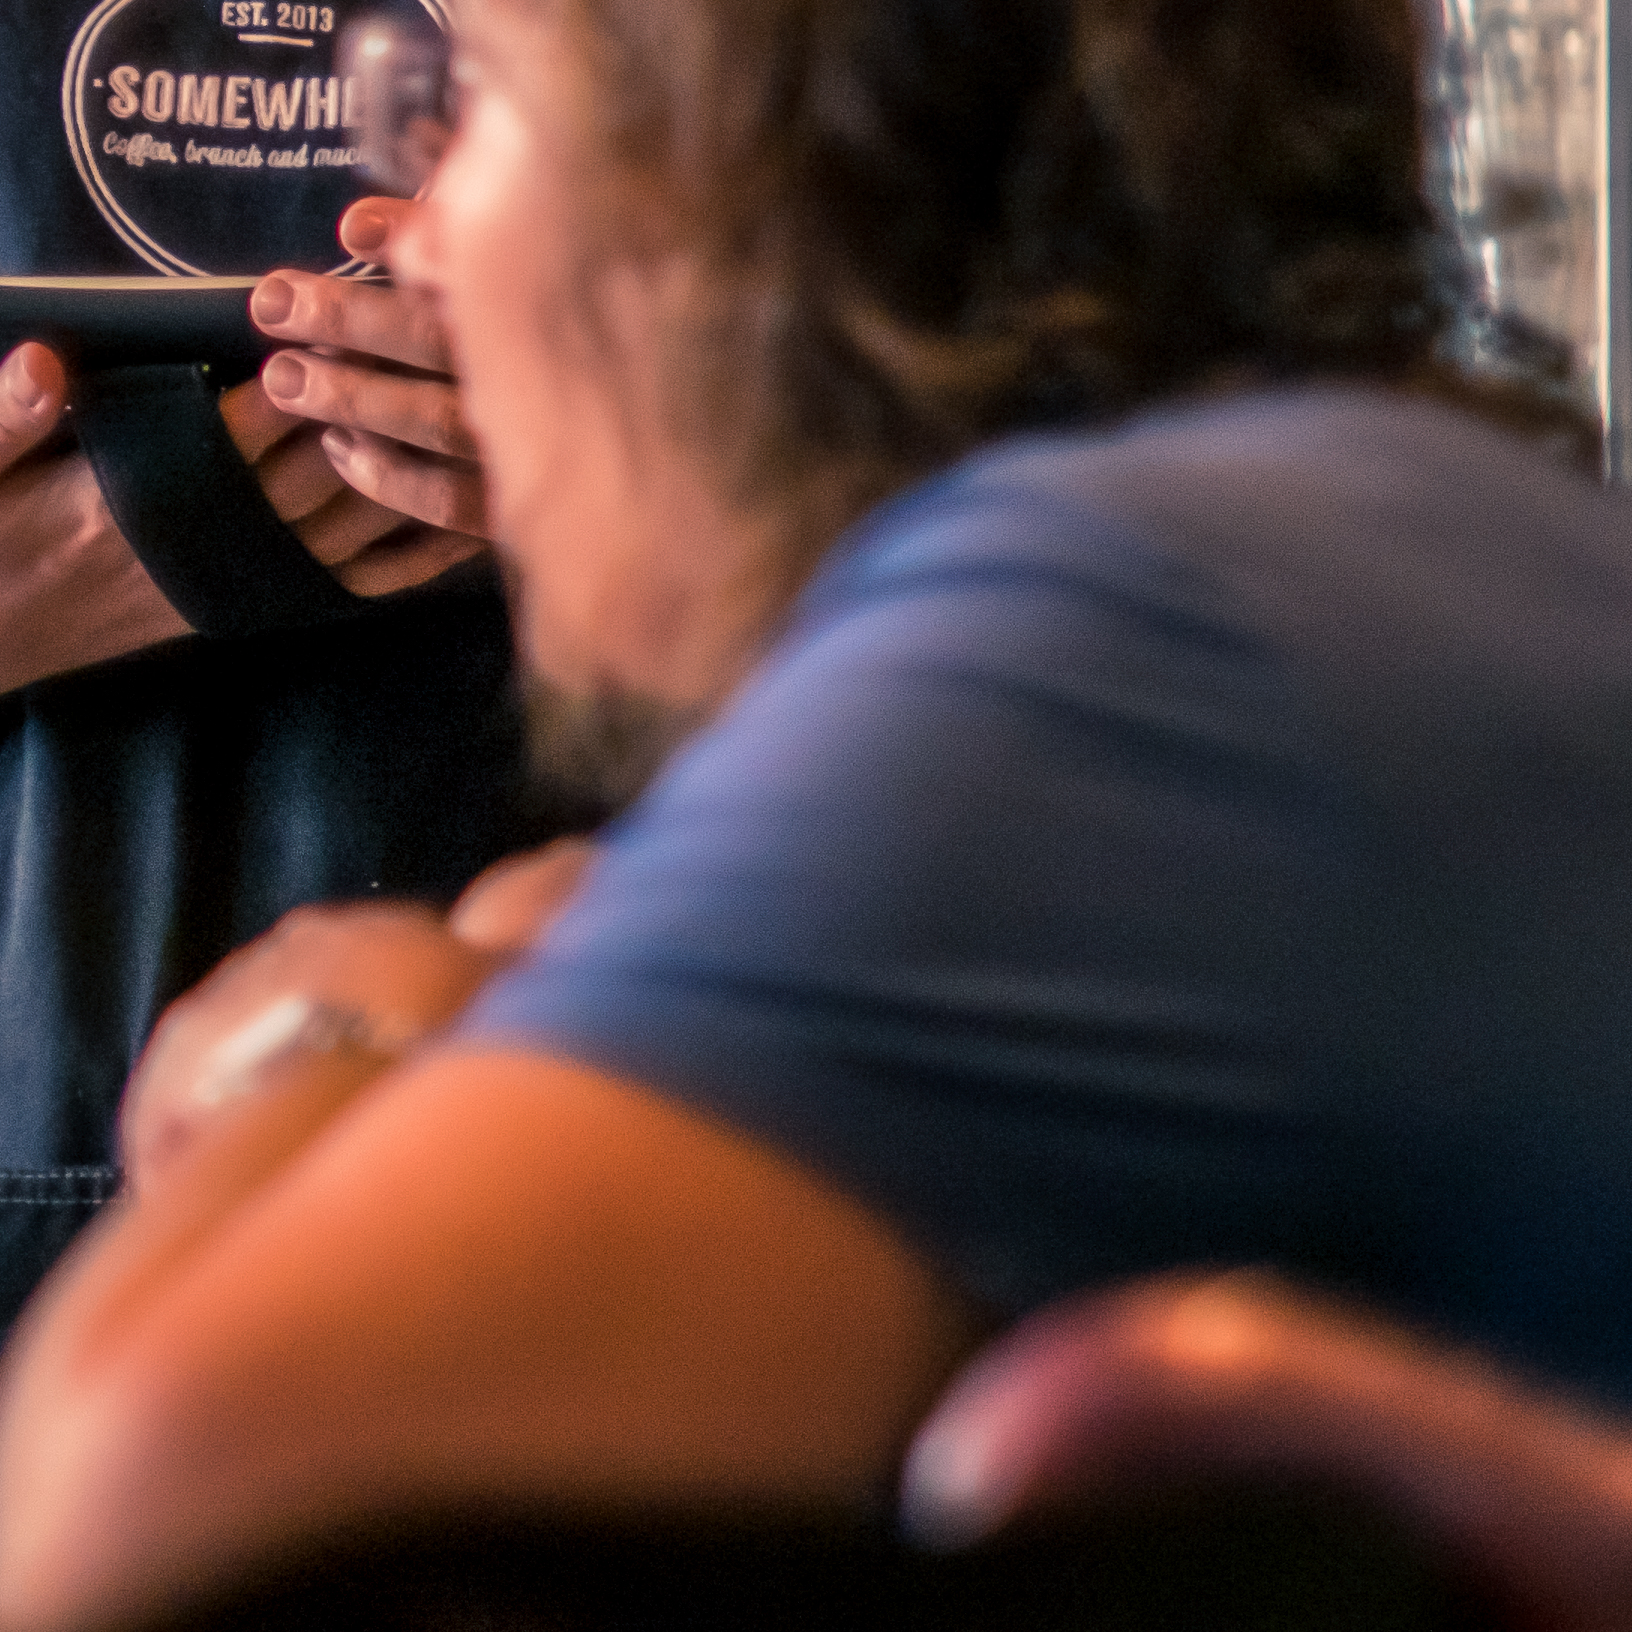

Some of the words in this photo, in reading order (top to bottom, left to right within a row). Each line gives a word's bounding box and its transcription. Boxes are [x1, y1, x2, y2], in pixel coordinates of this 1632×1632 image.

[222, 0, 269, 27] EST.
[276, 1, 335, 33] 2013
[185, 139, 264, 168] brunch
[267, 142, 309, 168] and
